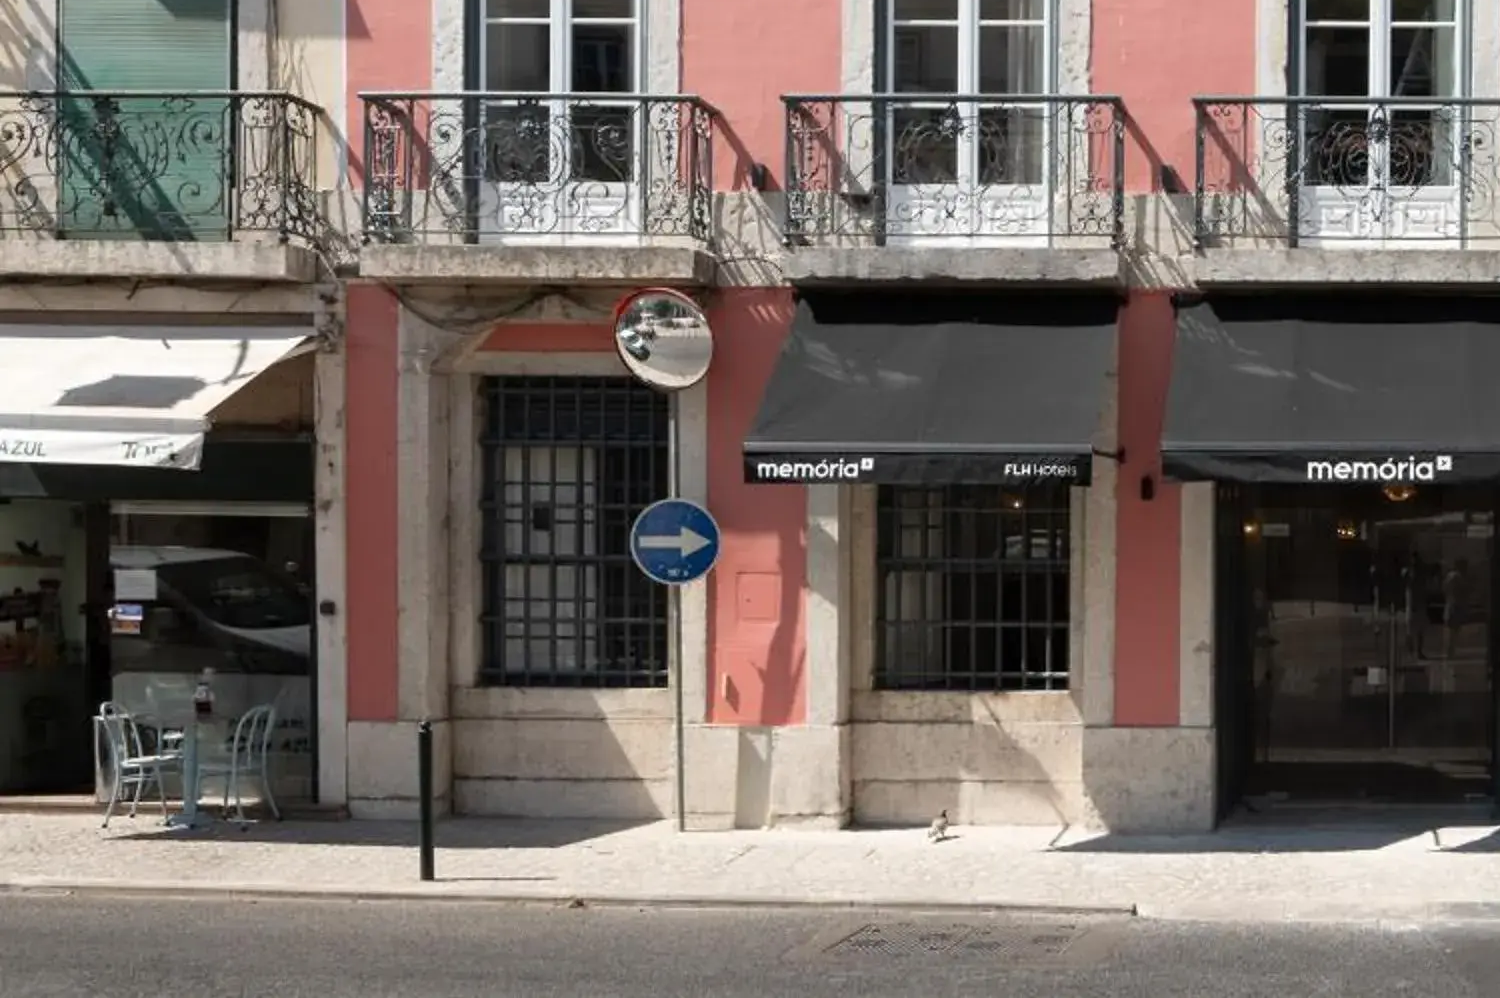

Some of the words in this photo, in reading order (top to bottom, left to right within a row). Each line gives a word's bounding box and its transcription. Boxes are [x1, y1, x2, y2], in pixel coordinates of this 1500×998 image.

[0, 439, 47, 457] AZUL
[757, 458, 859, 479] memória
[1004, 463, 1031, 476] FLH
[1307, 455, 1434, 480] memória
